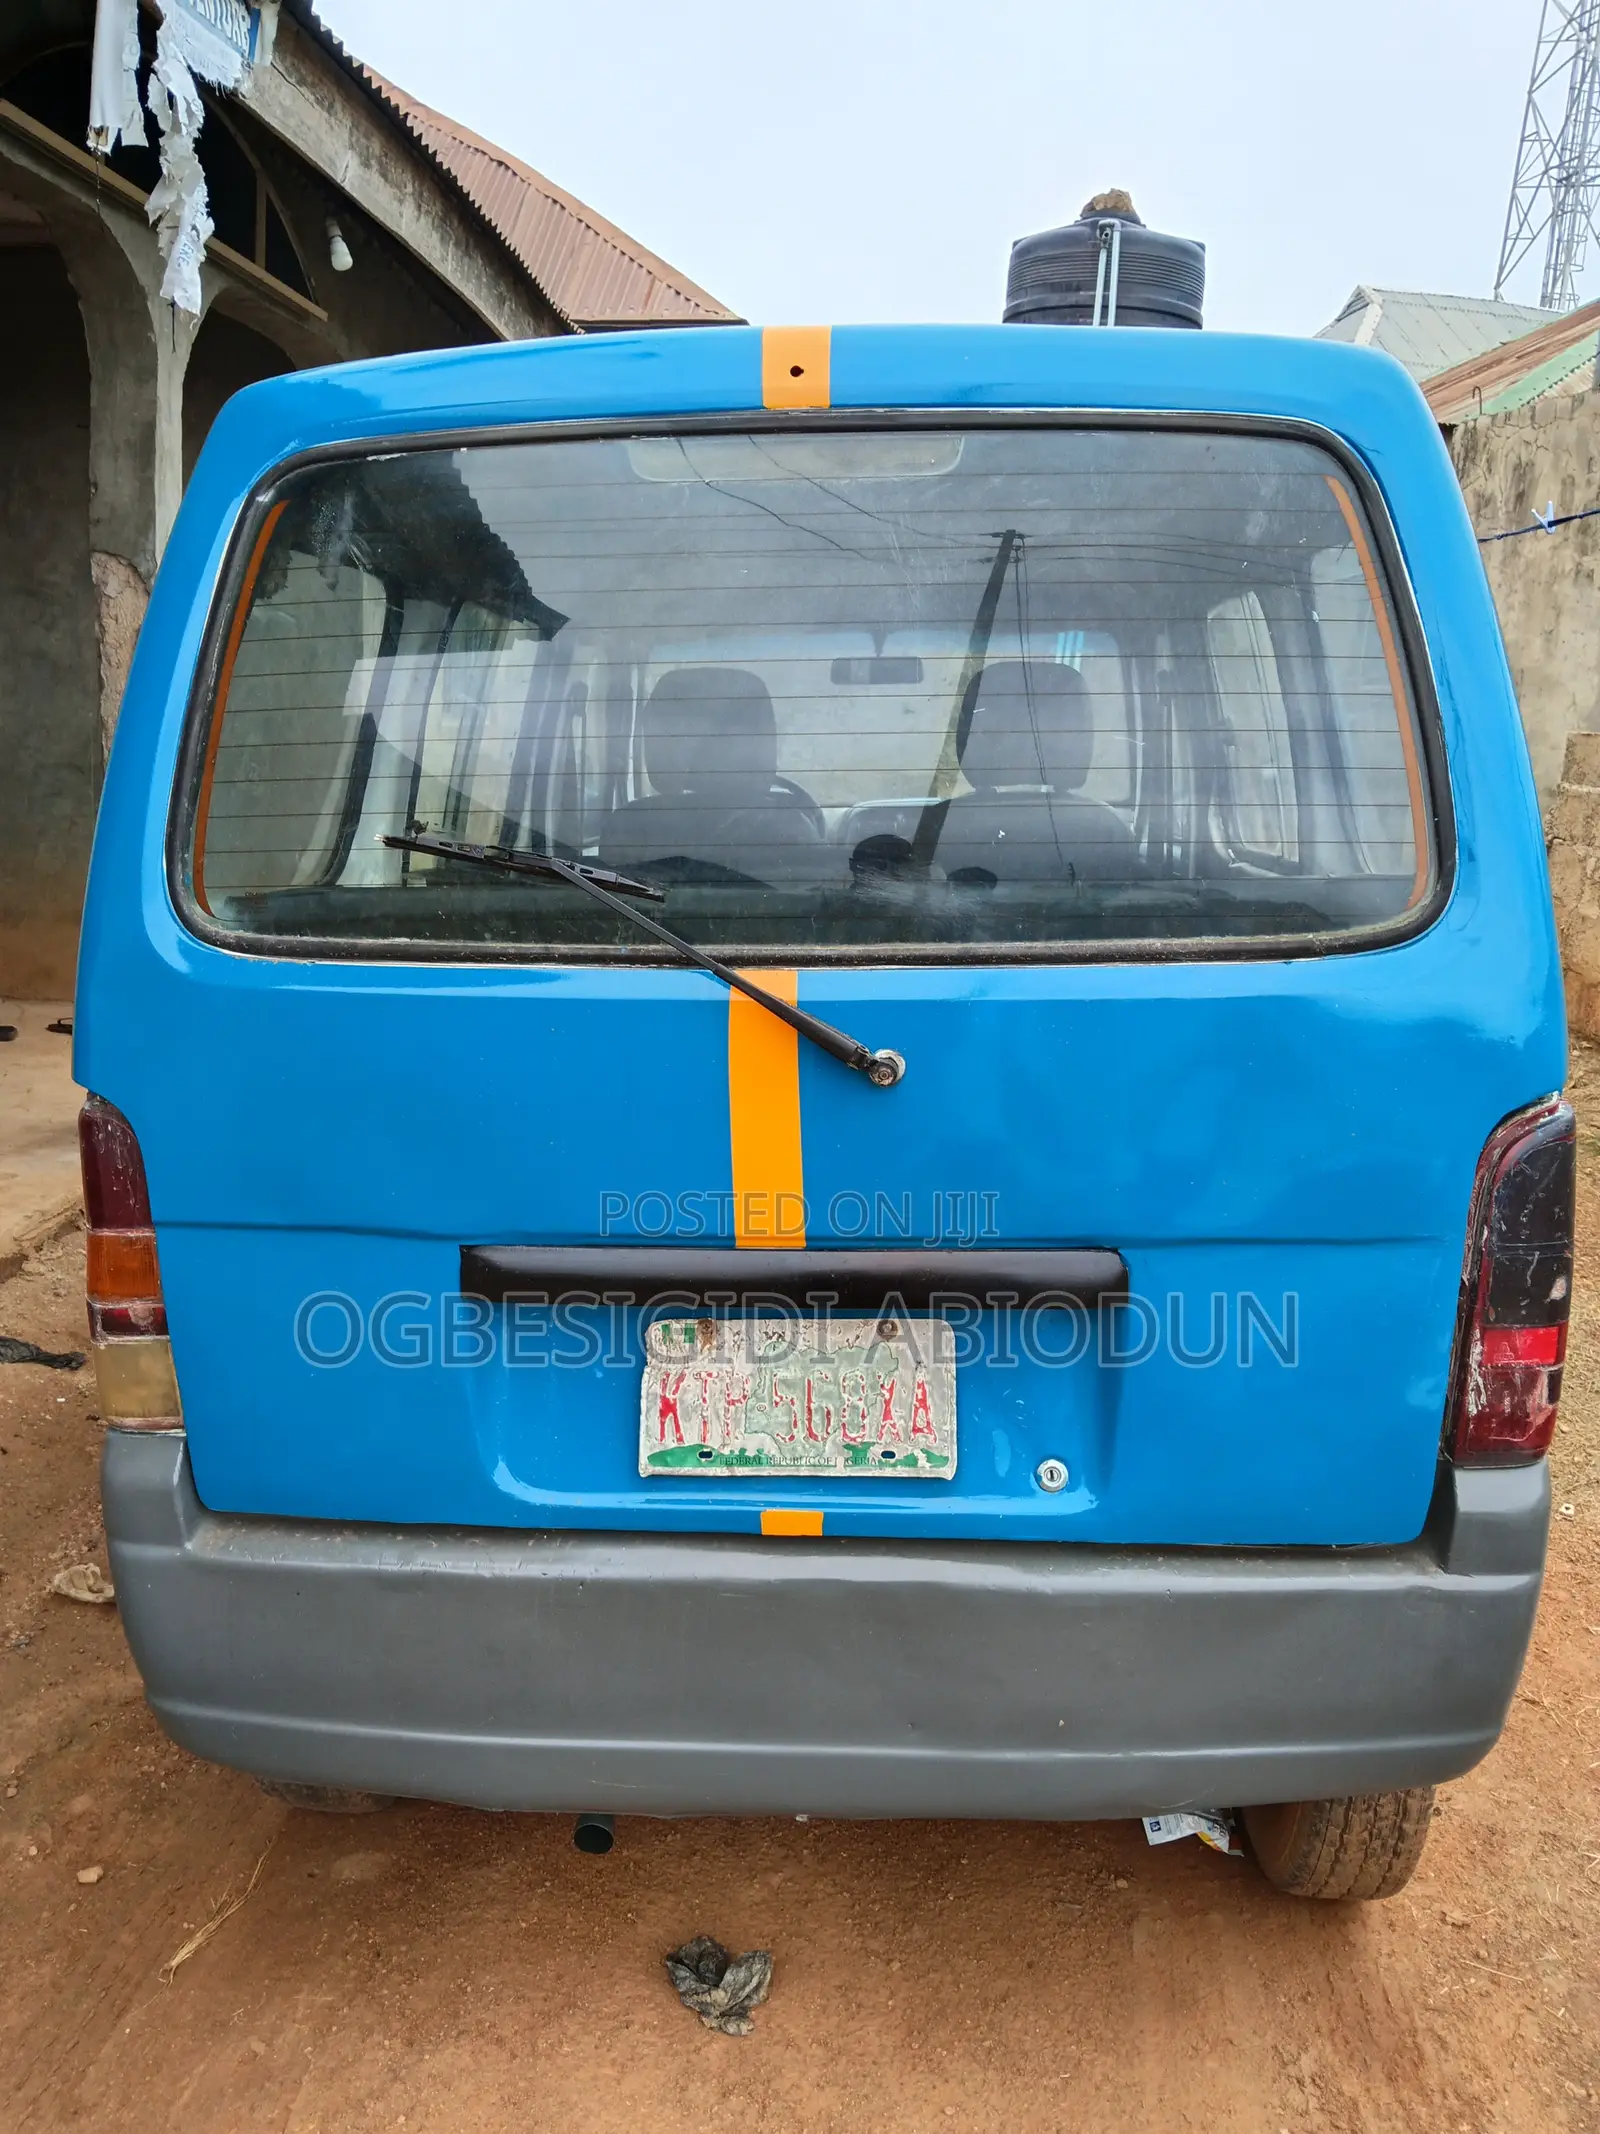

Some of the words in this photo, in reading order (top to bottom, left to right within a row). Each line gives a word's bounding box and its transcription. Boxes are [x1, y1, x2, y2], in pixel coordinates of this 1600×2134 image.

[720, 1456, 764, 1466] FEDERAL
[766, 1456, 817, 1466] REPUBLIC
[818, 1456, 833, 1466] OF
[834, 1456, 877, 1466] IGERIA
